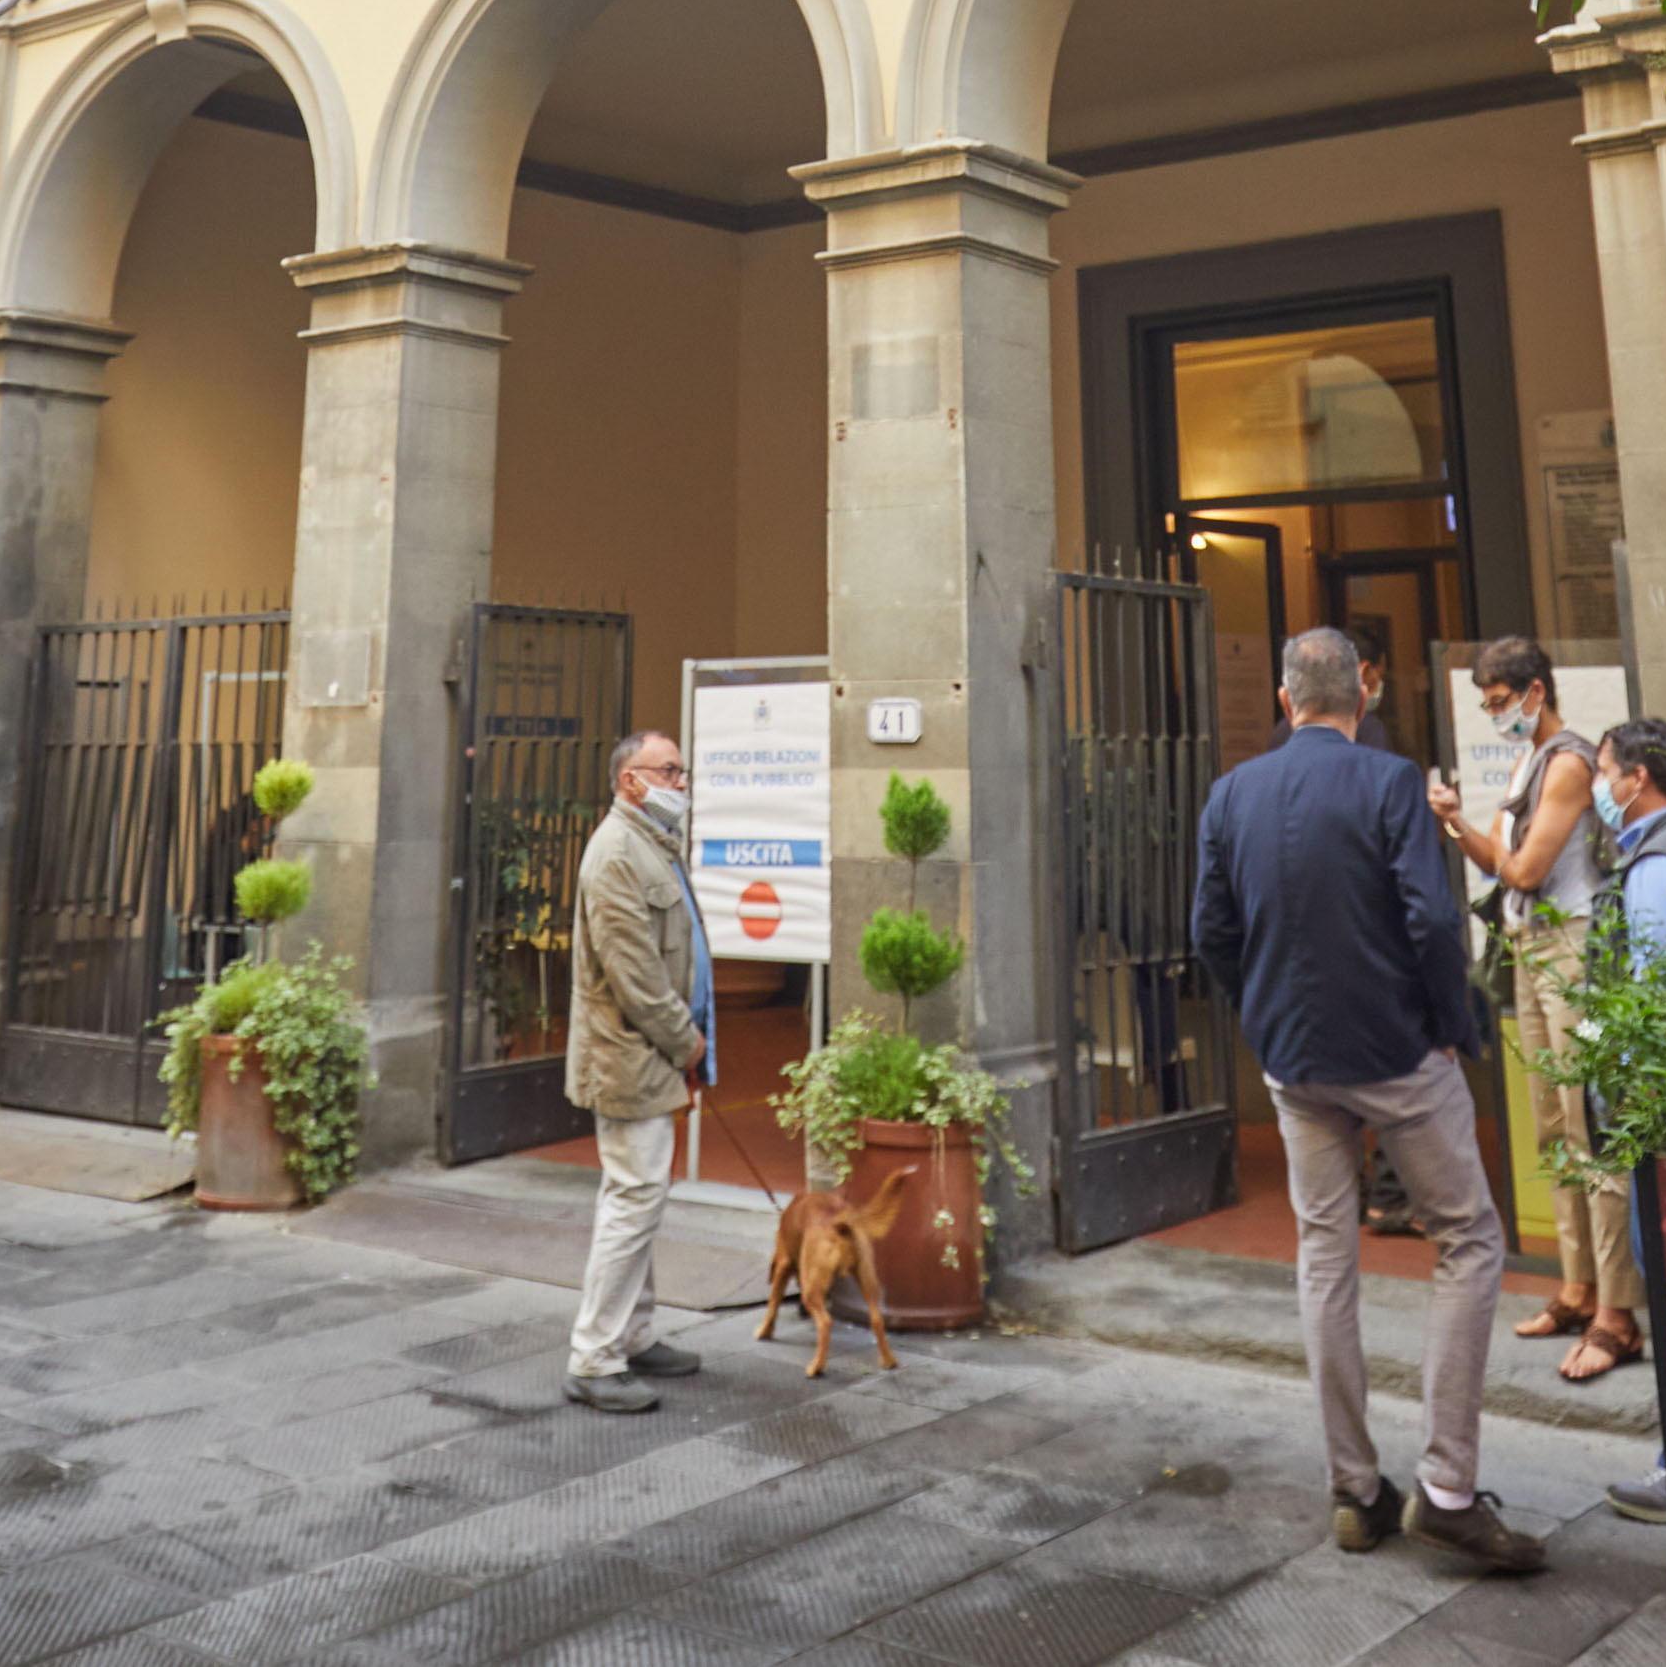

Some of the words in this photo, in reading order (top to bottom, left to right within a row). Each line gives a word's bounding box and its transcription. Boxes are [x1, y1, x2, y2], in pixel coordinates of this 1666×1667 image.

[878, 709, 904, 734] 41
[704, 751, 751, 765] UFFICIO
[753, 750, 821, 764] RELAZIONI
[1471, 744, 1528, 761] UFFIC
[710, 774, 735, 787] CON
[737, 774, 748, 786] IL
[752, 772, 815, 786] PUBBLICO
[1484, 770, 1510, 787] CO
[725, 842, 794, 866] USCITA
